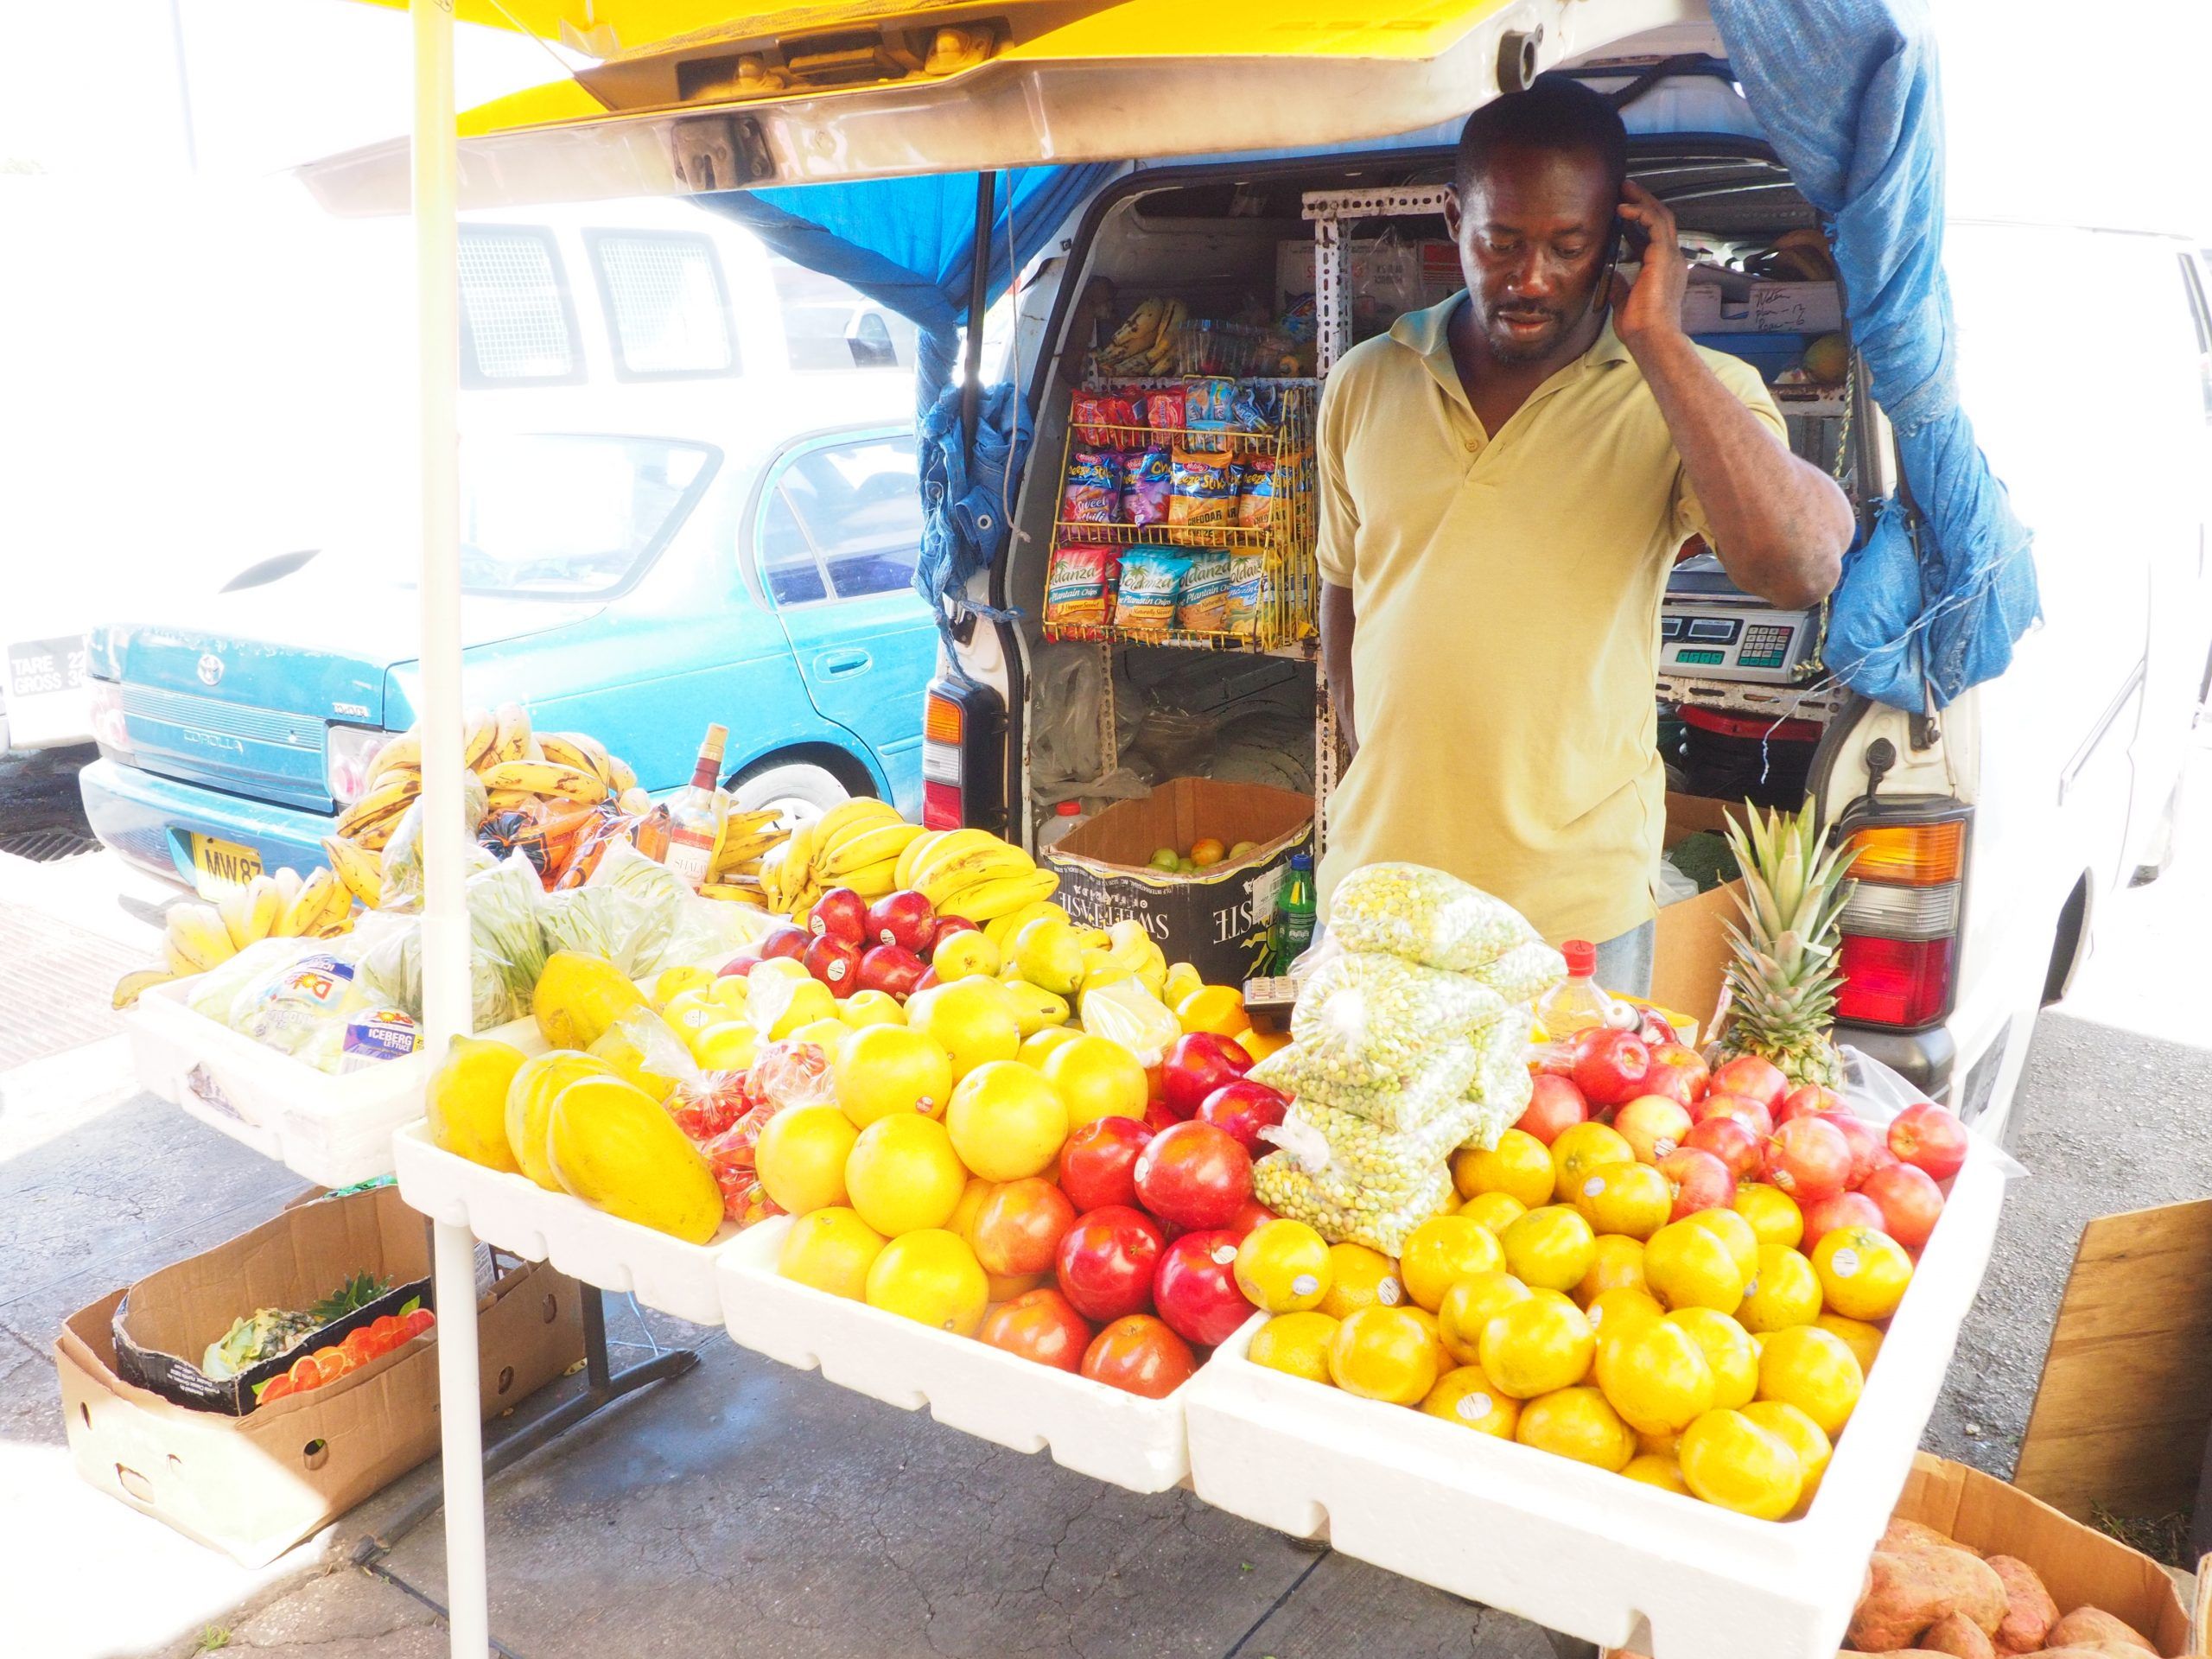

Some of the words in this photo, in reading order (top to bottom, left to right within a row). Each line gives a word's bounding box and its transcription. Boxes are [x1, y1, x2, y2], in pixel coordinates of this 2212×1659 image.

[1187, 510, 1223, 526] CHEDDAR
[1052, 588, 1080, 601] Plantain
[1154, 598, 1172, 607] Chips
[1186, 585, 1219, 603] Plantain
[11, 654, 54, 676] TARE
[15, 672, 62, 694] GROSS
[182, 729, 245, 755] COROLLA
[1057, 890, 1104, 931] TASTE
[368, 1028, 413, 1046] ICEBERG
[383, 1040, 410, 1052] LETTUCE
